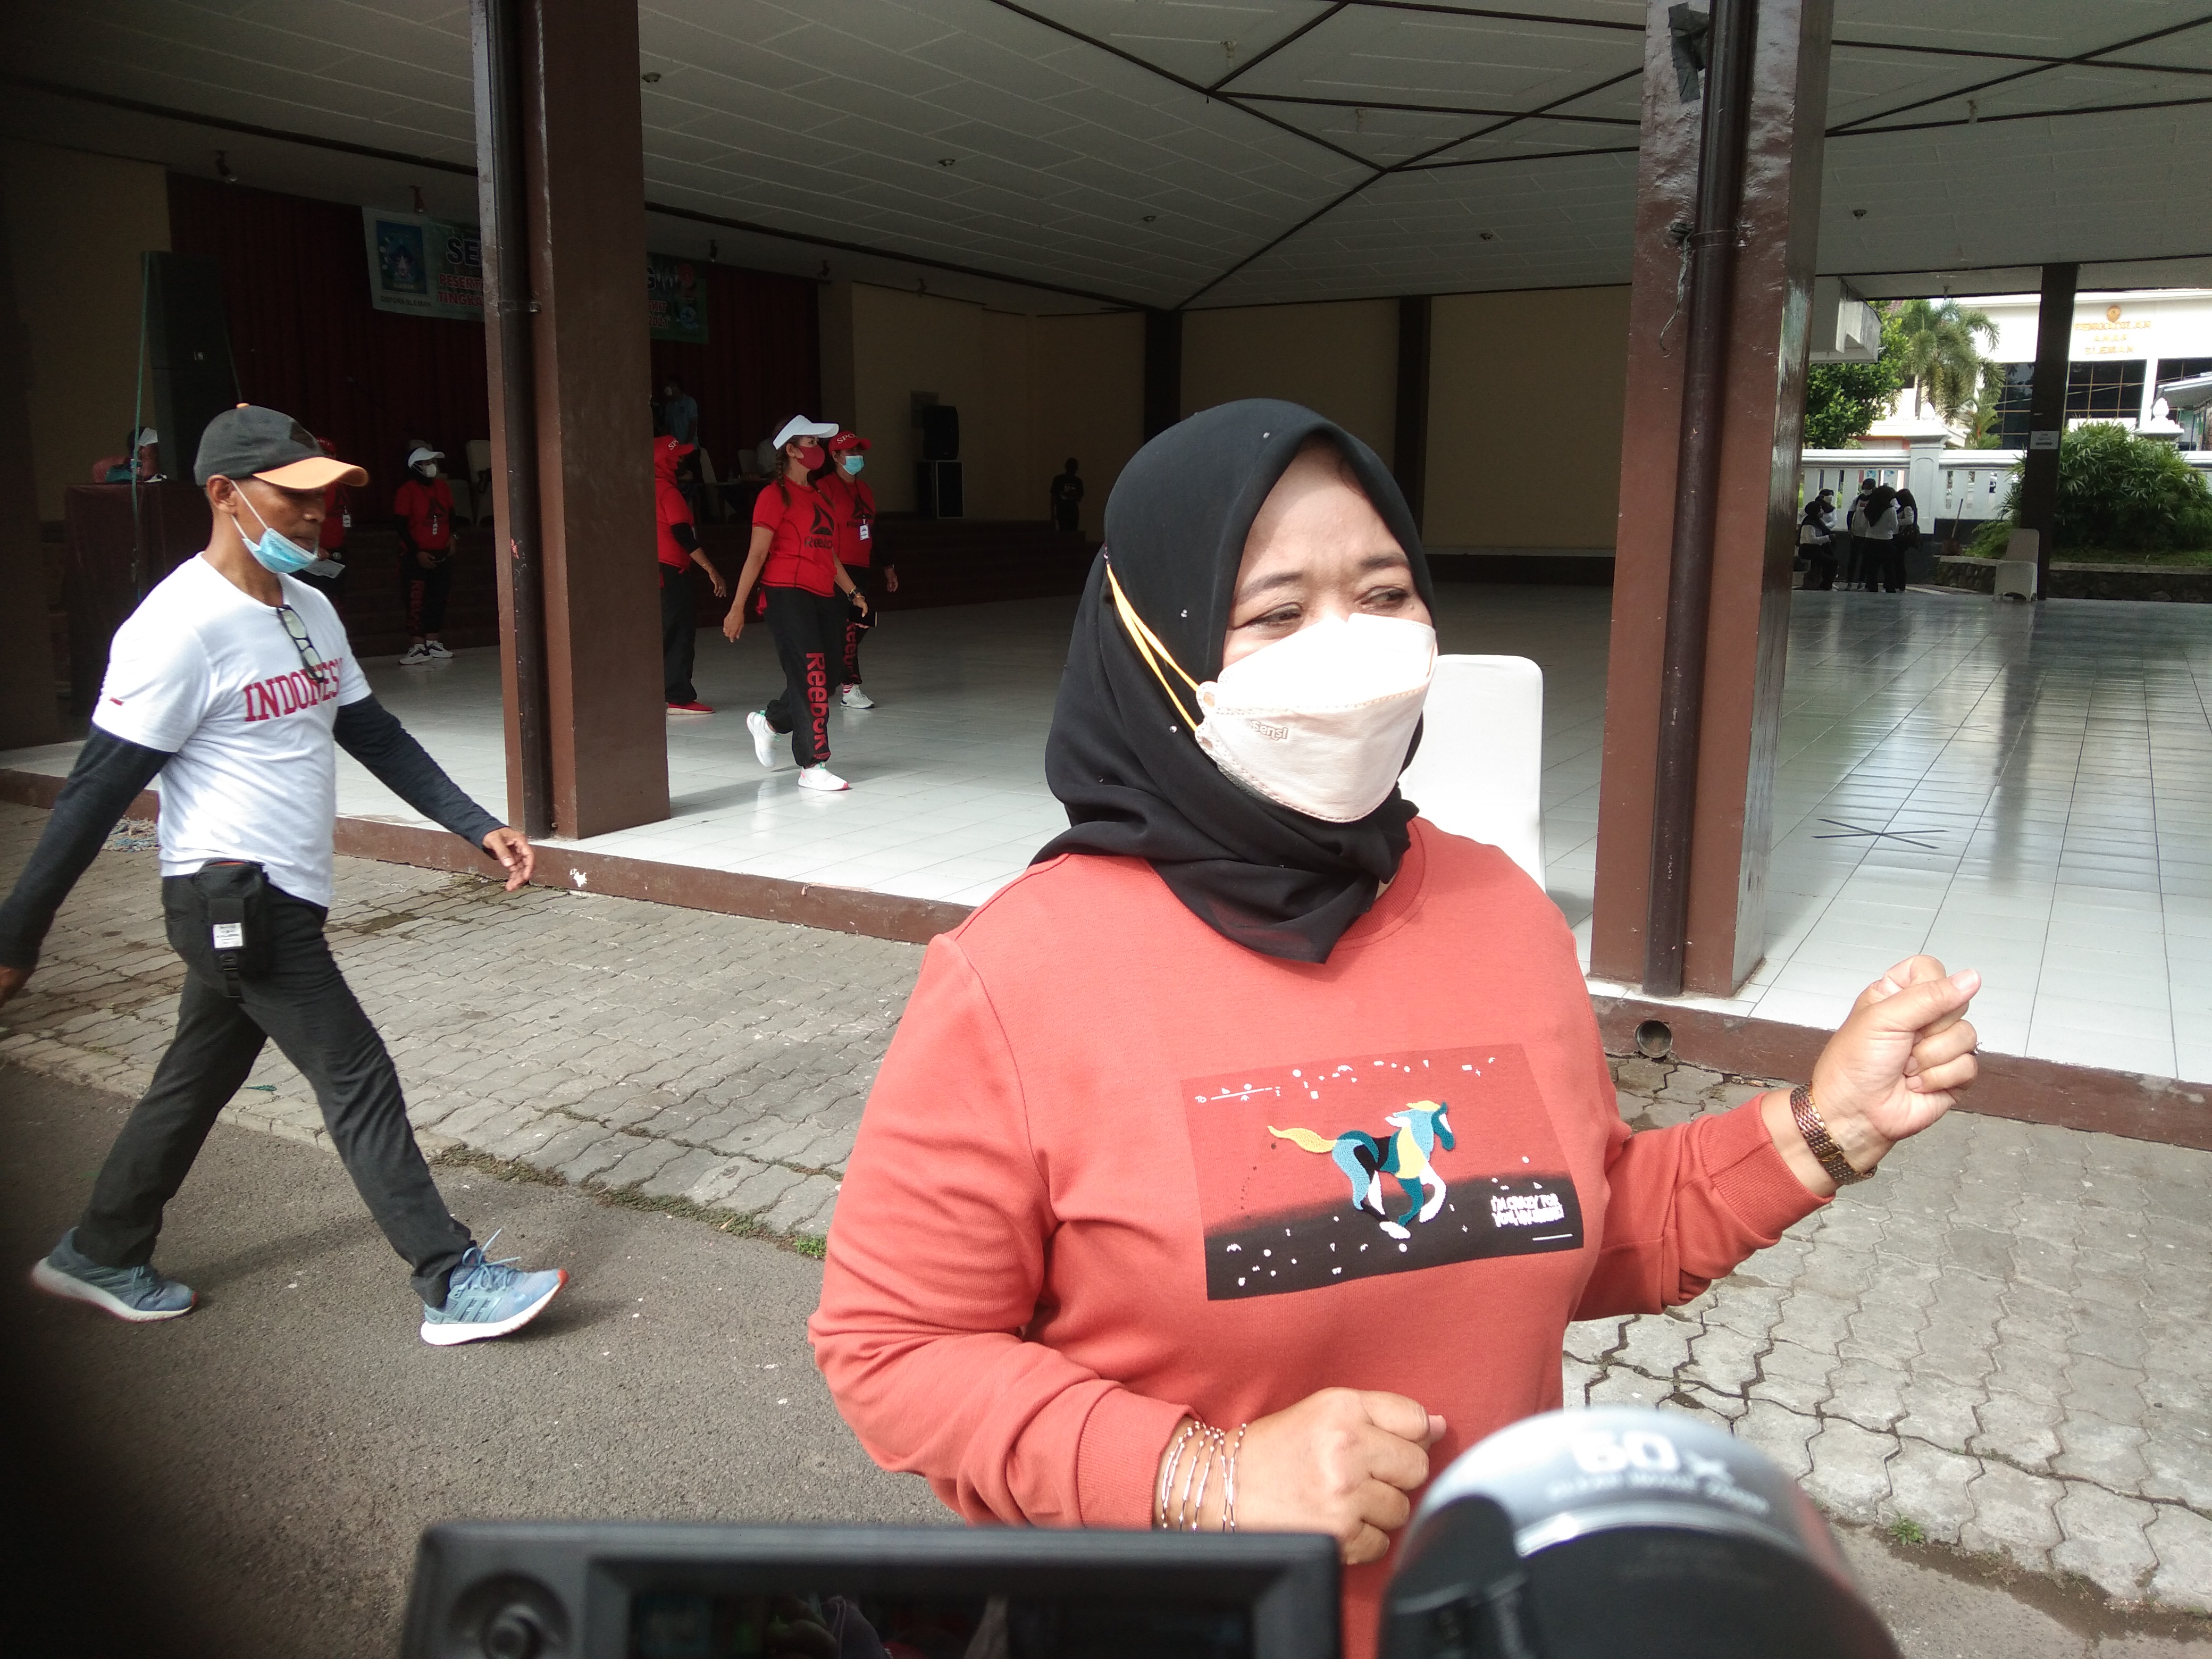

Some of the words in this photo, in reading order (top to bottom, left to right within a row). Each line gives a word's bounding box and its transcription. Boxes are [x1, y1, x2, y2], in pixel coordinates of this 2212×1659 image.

[446, 237, 481, 267] SE
[437, 290, 484, 307] TINGKA
[837, 433, 857, 444] SPO
[806, 652, 830, 751] Reebok
[1251, 720, 1288, 741] Sensi
